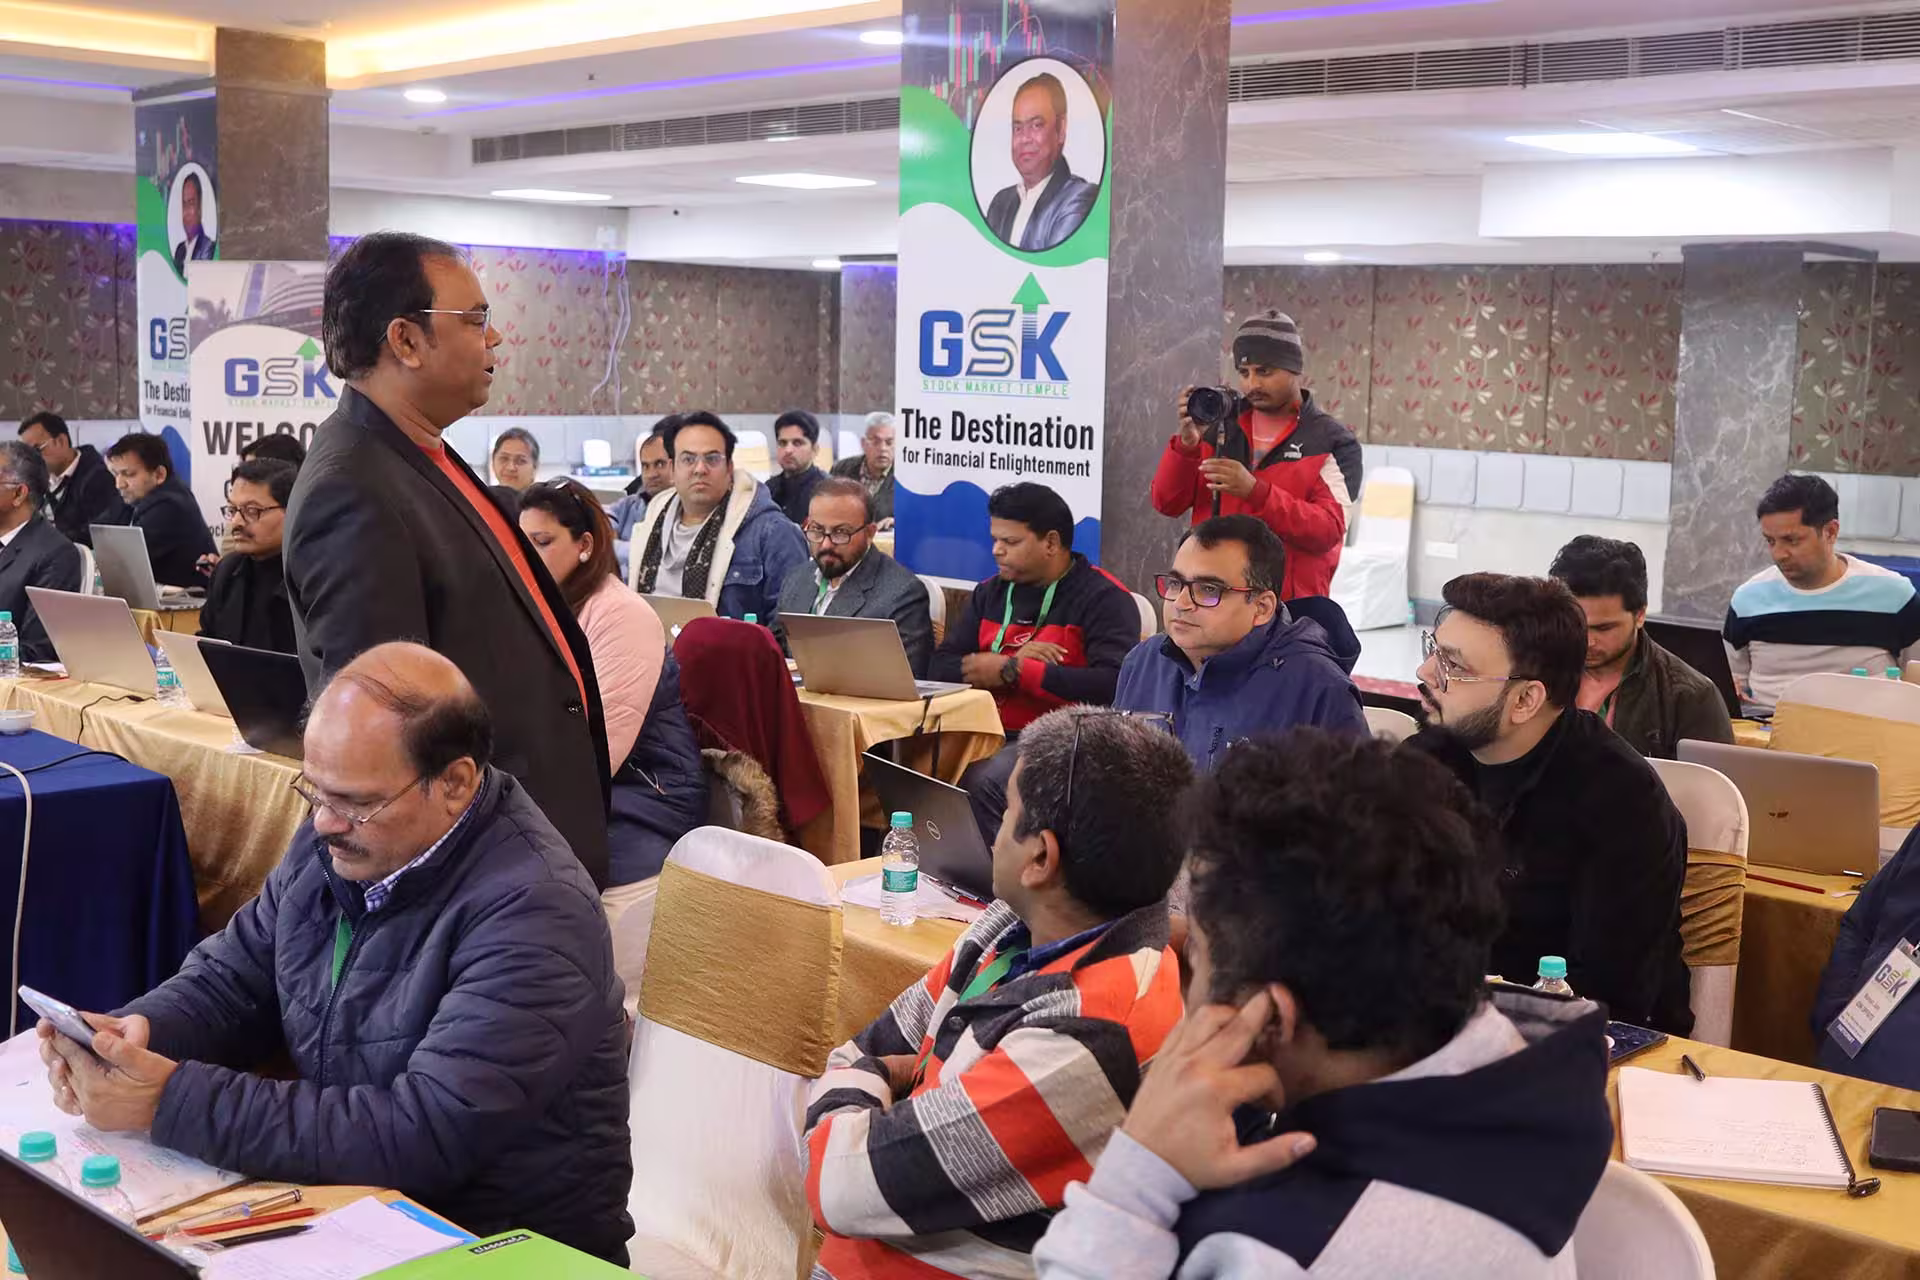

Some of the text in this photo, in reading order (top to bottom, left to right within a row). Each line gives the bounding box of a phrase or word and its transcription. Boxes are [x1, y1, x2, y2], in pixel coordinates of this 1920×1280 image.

[919, 309, 1071, 381] GSK
[144, 380, 160, 400] The
[225, 357, 337, 398] GSK
[922, 380, 1068, 396] STOCK MARKET TEMPLE
[901, 408, 1095, 451] The Destination
[902, 446, 1091, 477] for Financial Enlightenment
